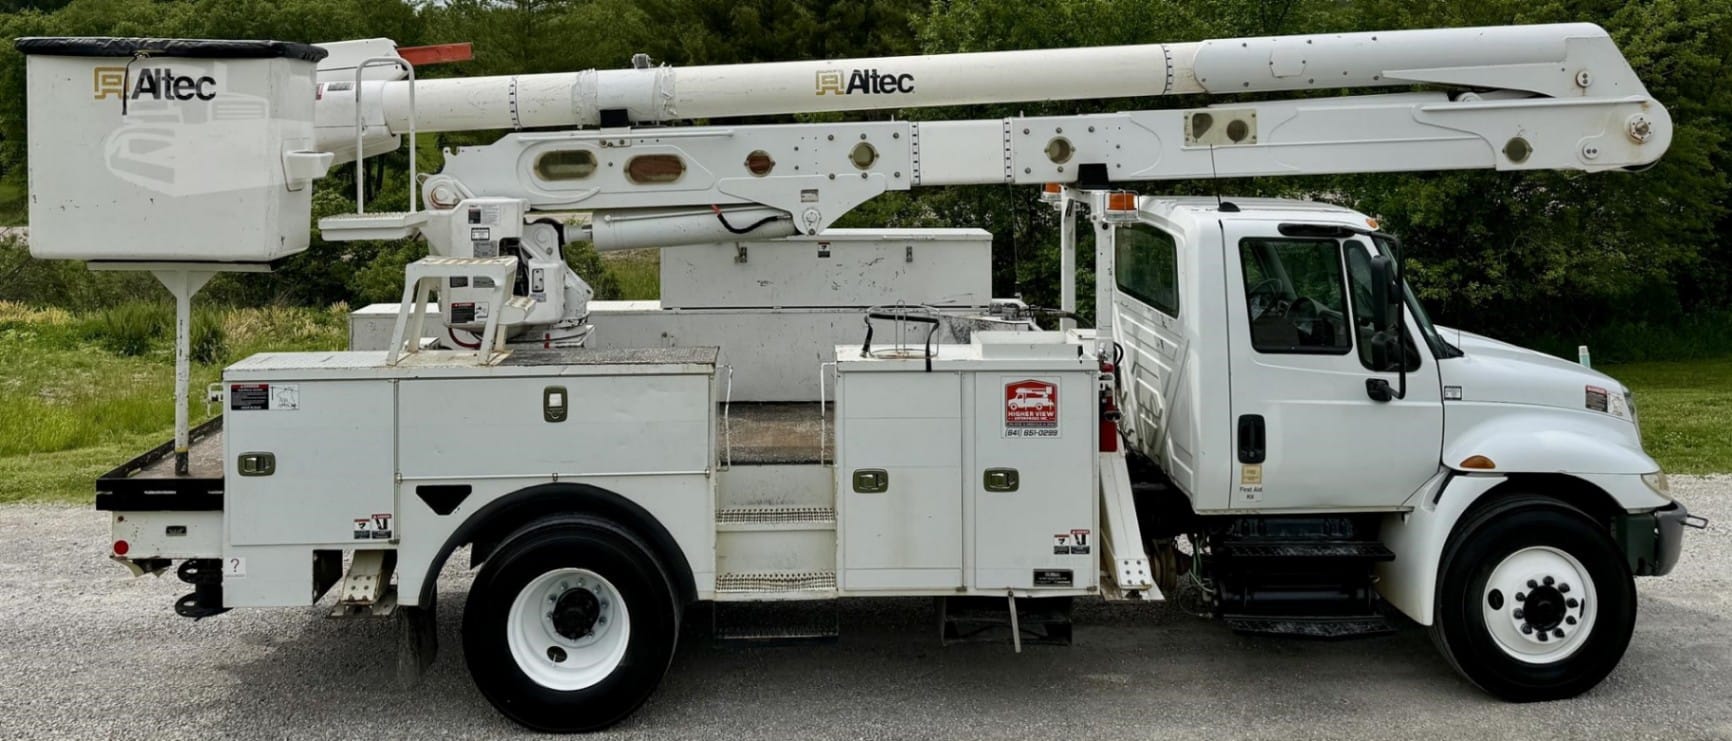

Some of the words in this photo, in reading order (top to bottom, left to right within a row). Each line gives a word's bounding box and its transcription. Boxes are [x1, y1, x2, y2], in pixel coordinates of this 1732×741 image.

[131, 68, 216, 101] Altec
[846, 68, 914, 94] Altec
[230, 558, 240, 573] ?
